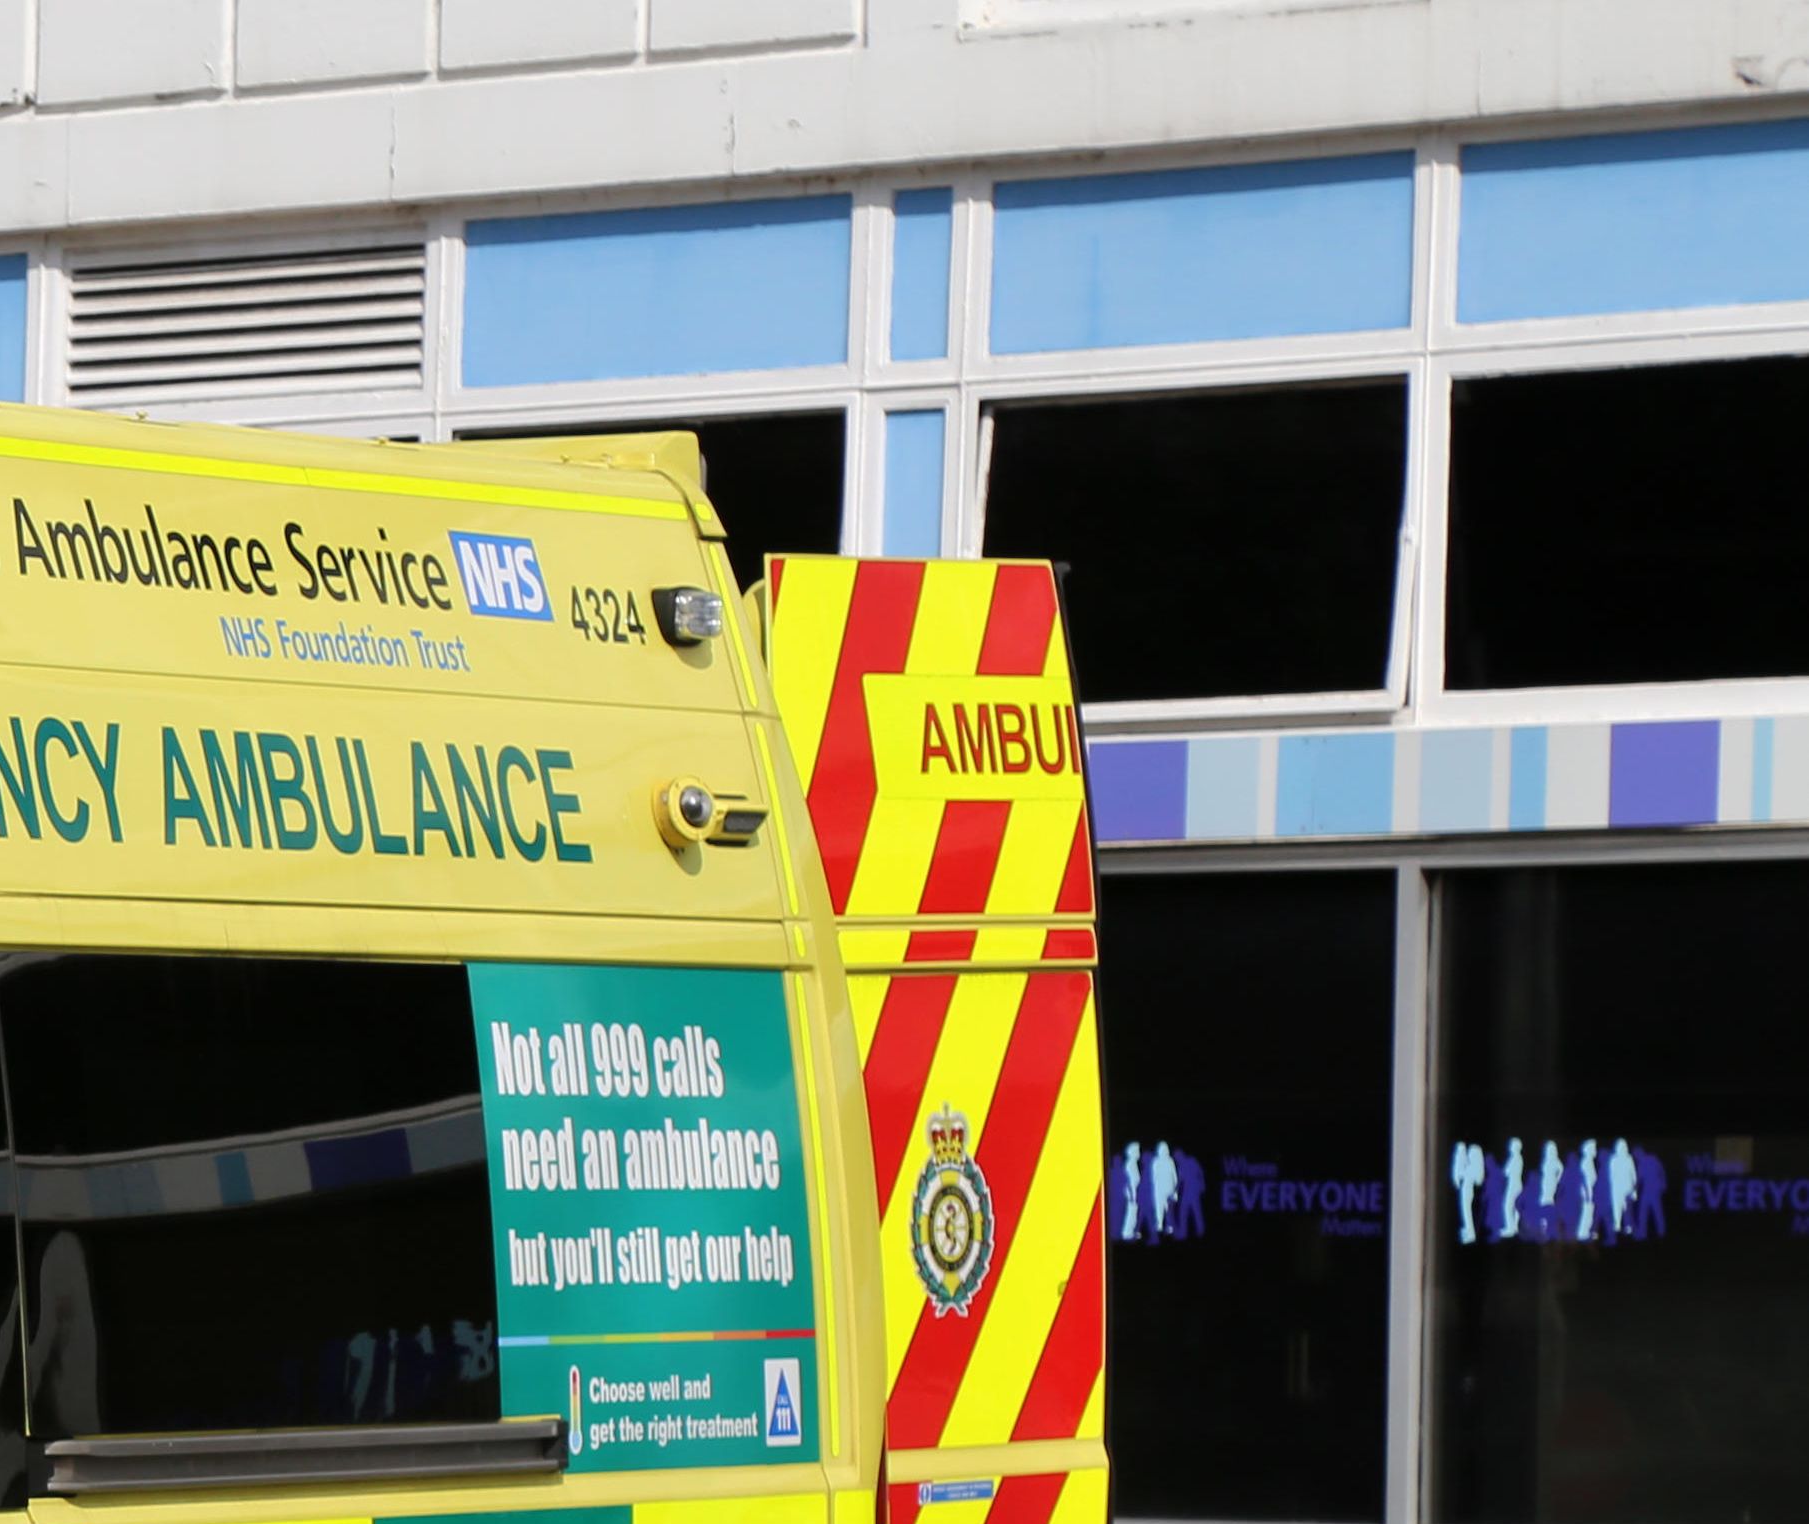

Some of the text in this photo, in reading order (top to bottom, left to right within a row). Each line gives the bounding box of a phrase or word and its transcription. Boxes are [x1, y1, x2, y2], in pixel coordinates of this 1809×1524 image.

[13, 496, 270, 597] Ambulance
[284, 523, 452, 611] Service
[459, 538, 545, 614] NHS
[570, 585, 648, 645] 4324
[219, 616, 471, 673] NHS Foundation Trust
[162, 726, 594, 864] AMBULANCE
[491, 1021, 725, 1099] Not all 999 calls
[501, 1116, 781, 1191] need an ambulance
[1223, 1154, 1278, 1176] Where
[1221, 1179, 1385, 1212] EVERYONE
[1684, 1178, 1809, 1211] EVERYO
[508, 1225, 794, 1291] but you'll still get our help
[589, 1373, 712, 1404] Choose well and
[590, 1411, 759, 1450] get the right treatment
[775, 1406, 791, 1431] 111
